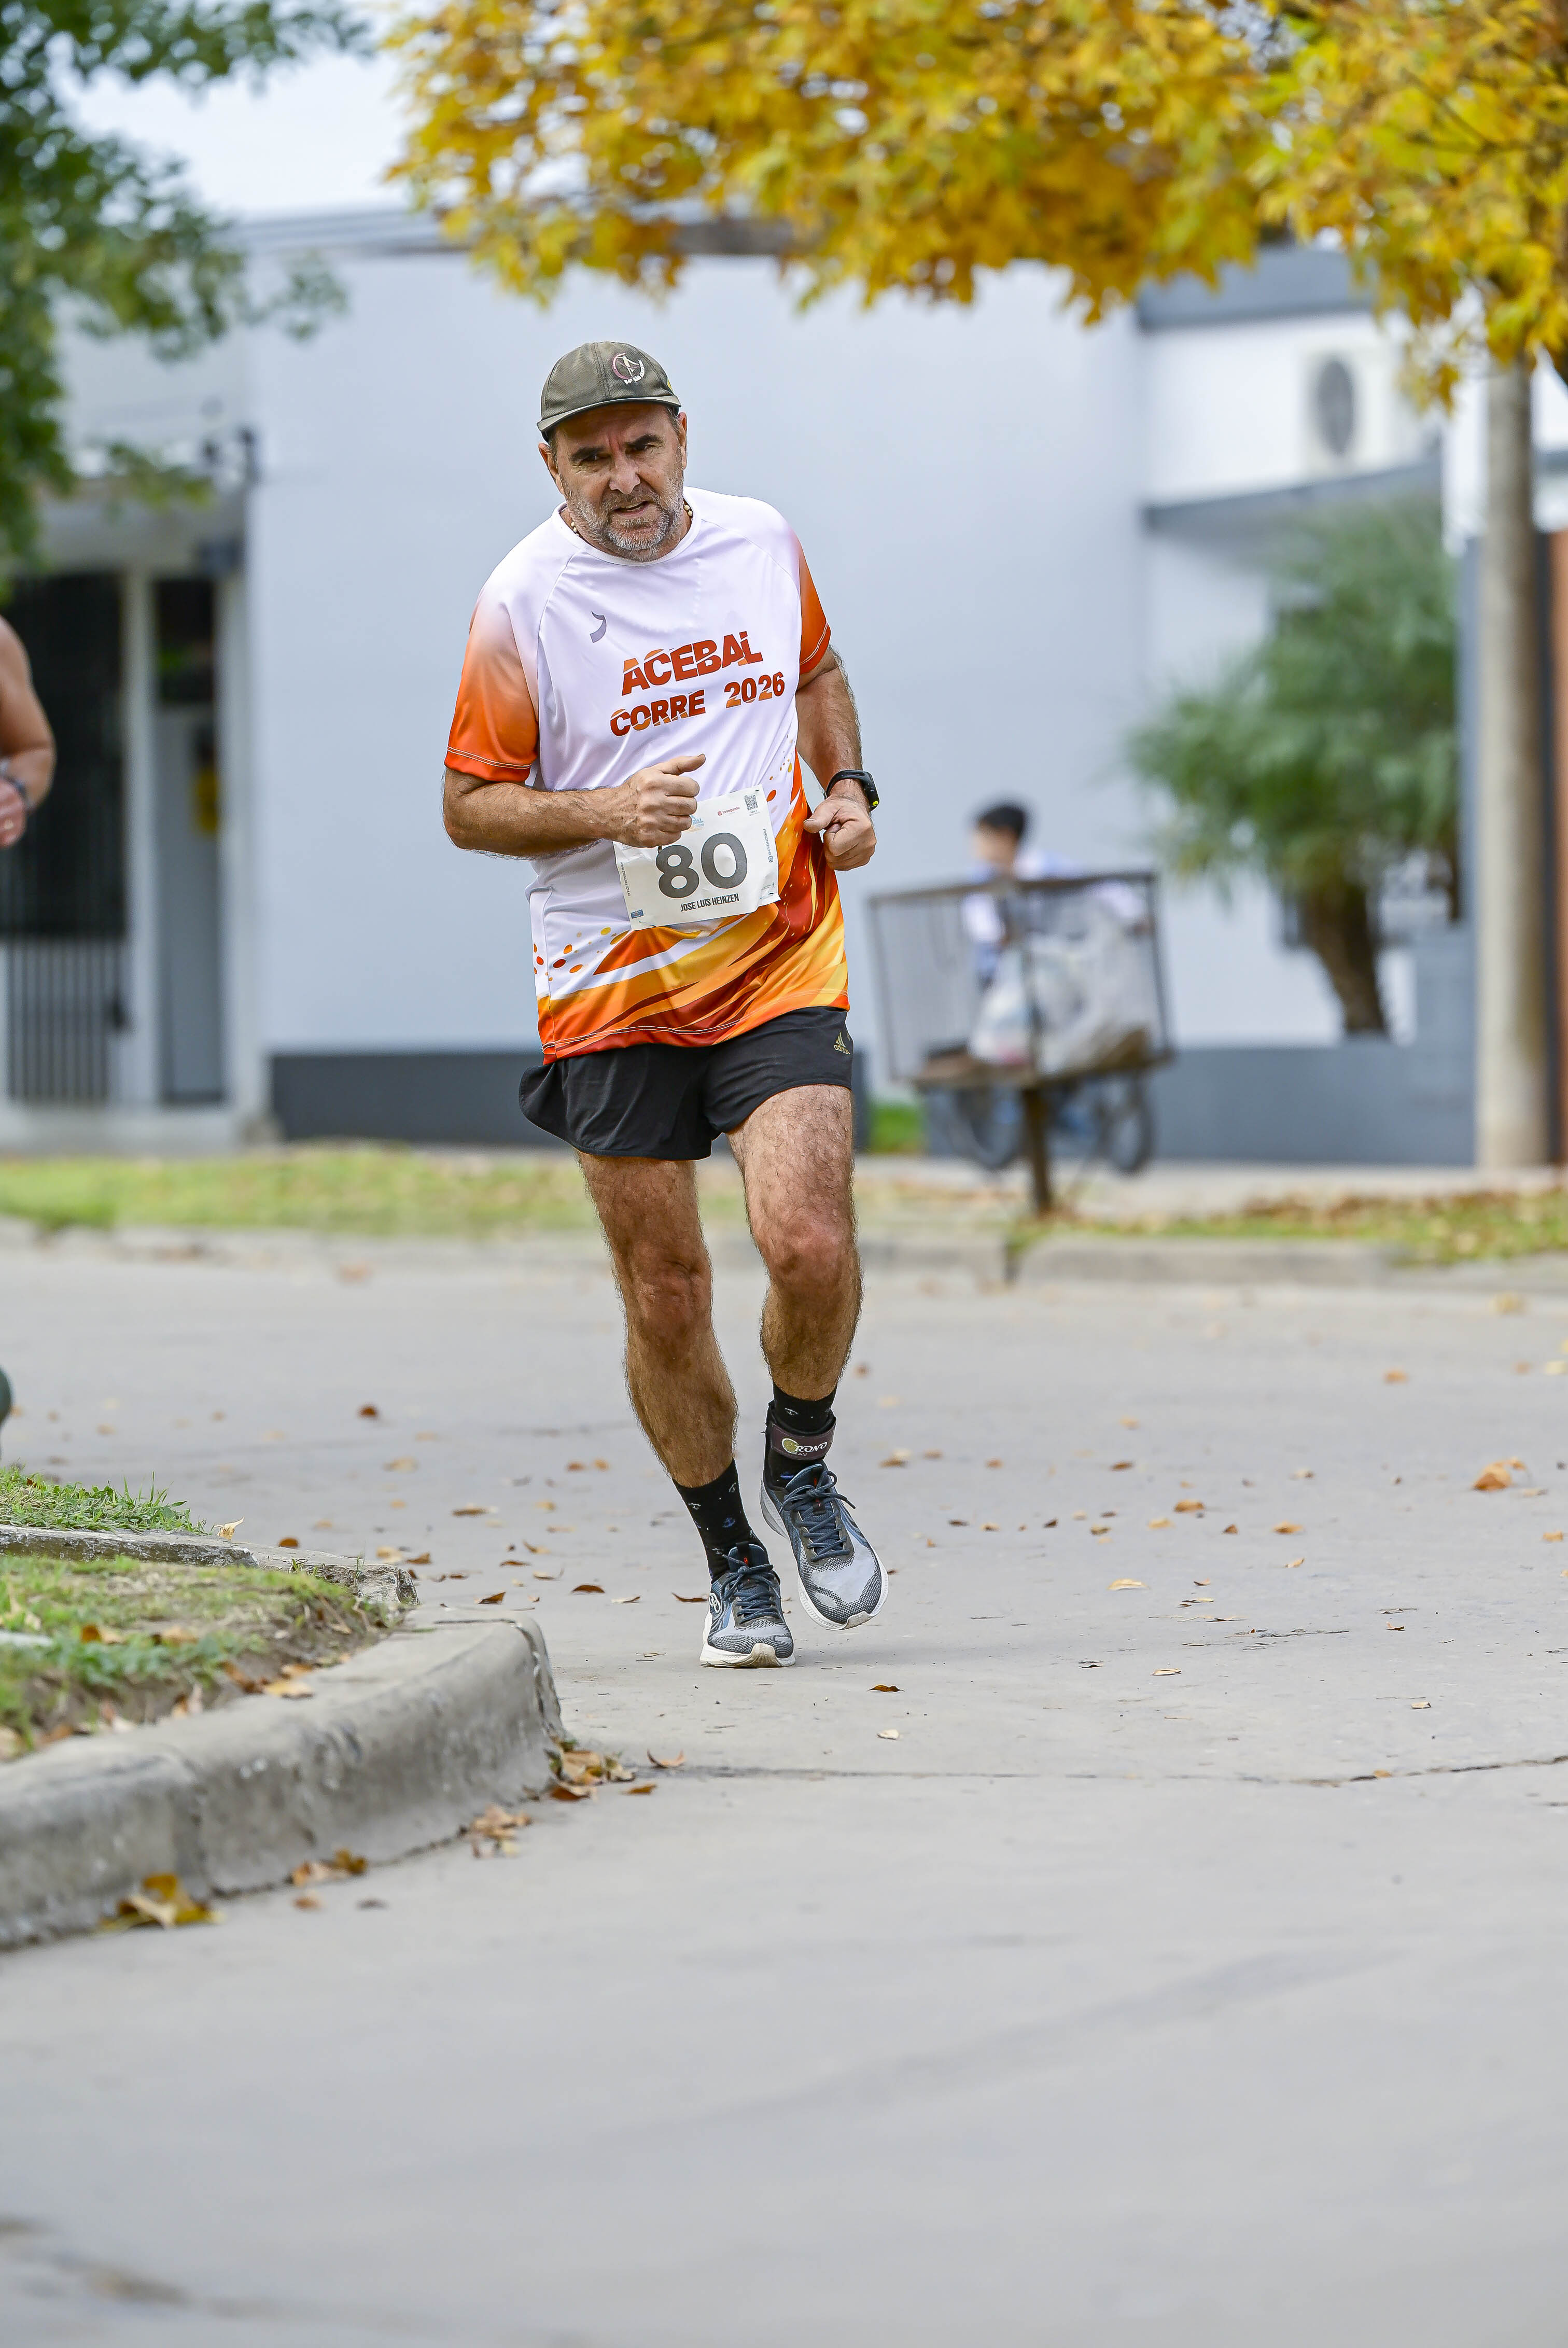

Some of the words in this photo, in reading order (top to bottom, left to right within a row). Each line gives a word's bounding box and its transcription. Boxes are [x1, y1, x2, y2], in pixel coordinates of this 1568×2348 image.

[622, 631, 763, 696] ACEBAL
[610, 689, 706, 737] CORRE
[724, 672, 786, 709] 2026
[655, 832, 748, 899] 80
[681, 902, 696, 912] JOSE
[697, 898, 711, 908] LUIS
[711, 893, 739, 905] HEINZEN
